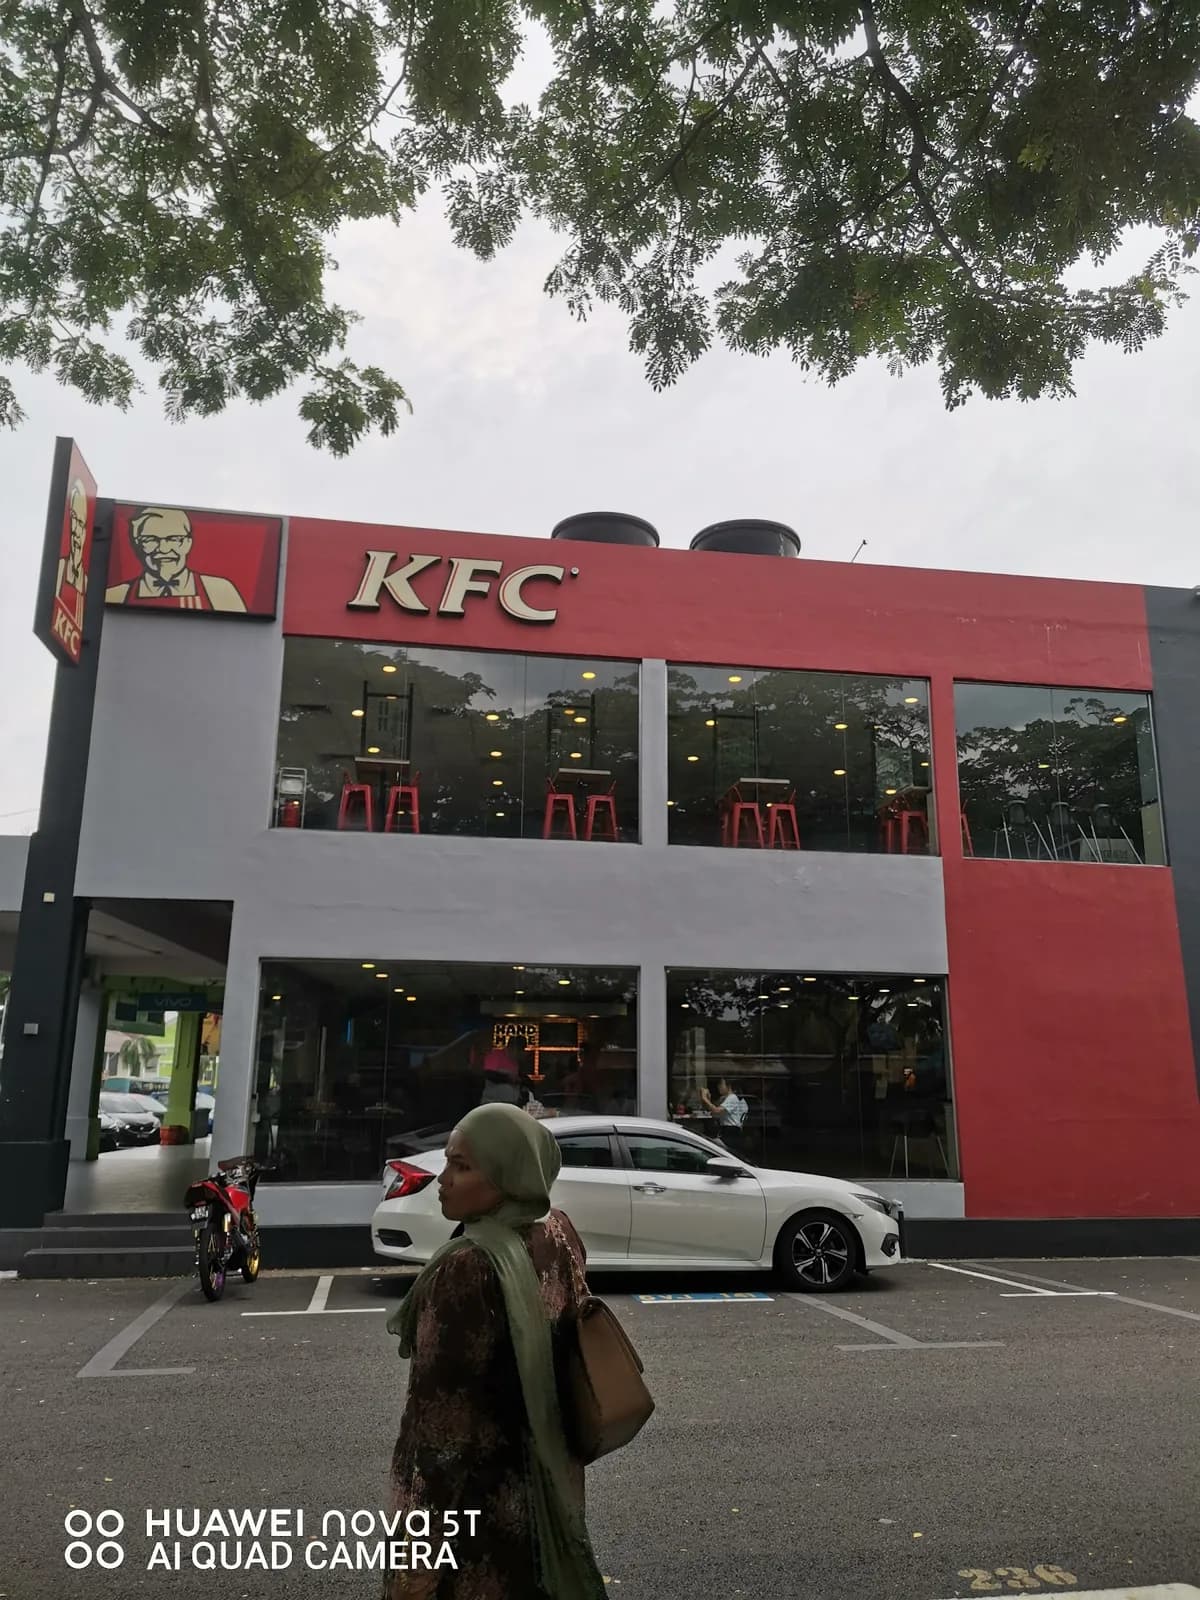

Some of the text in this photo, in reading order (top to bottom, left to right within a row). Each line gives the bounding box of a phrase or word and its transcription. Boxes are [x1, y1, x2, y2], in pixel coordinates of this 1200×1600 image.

[347, 549, 565, 624] KFC
[54, 606, 81, 656] KFC
[495, 1024, 537, 1036] HAND
[957, 1564, 1077, 1590] 236
